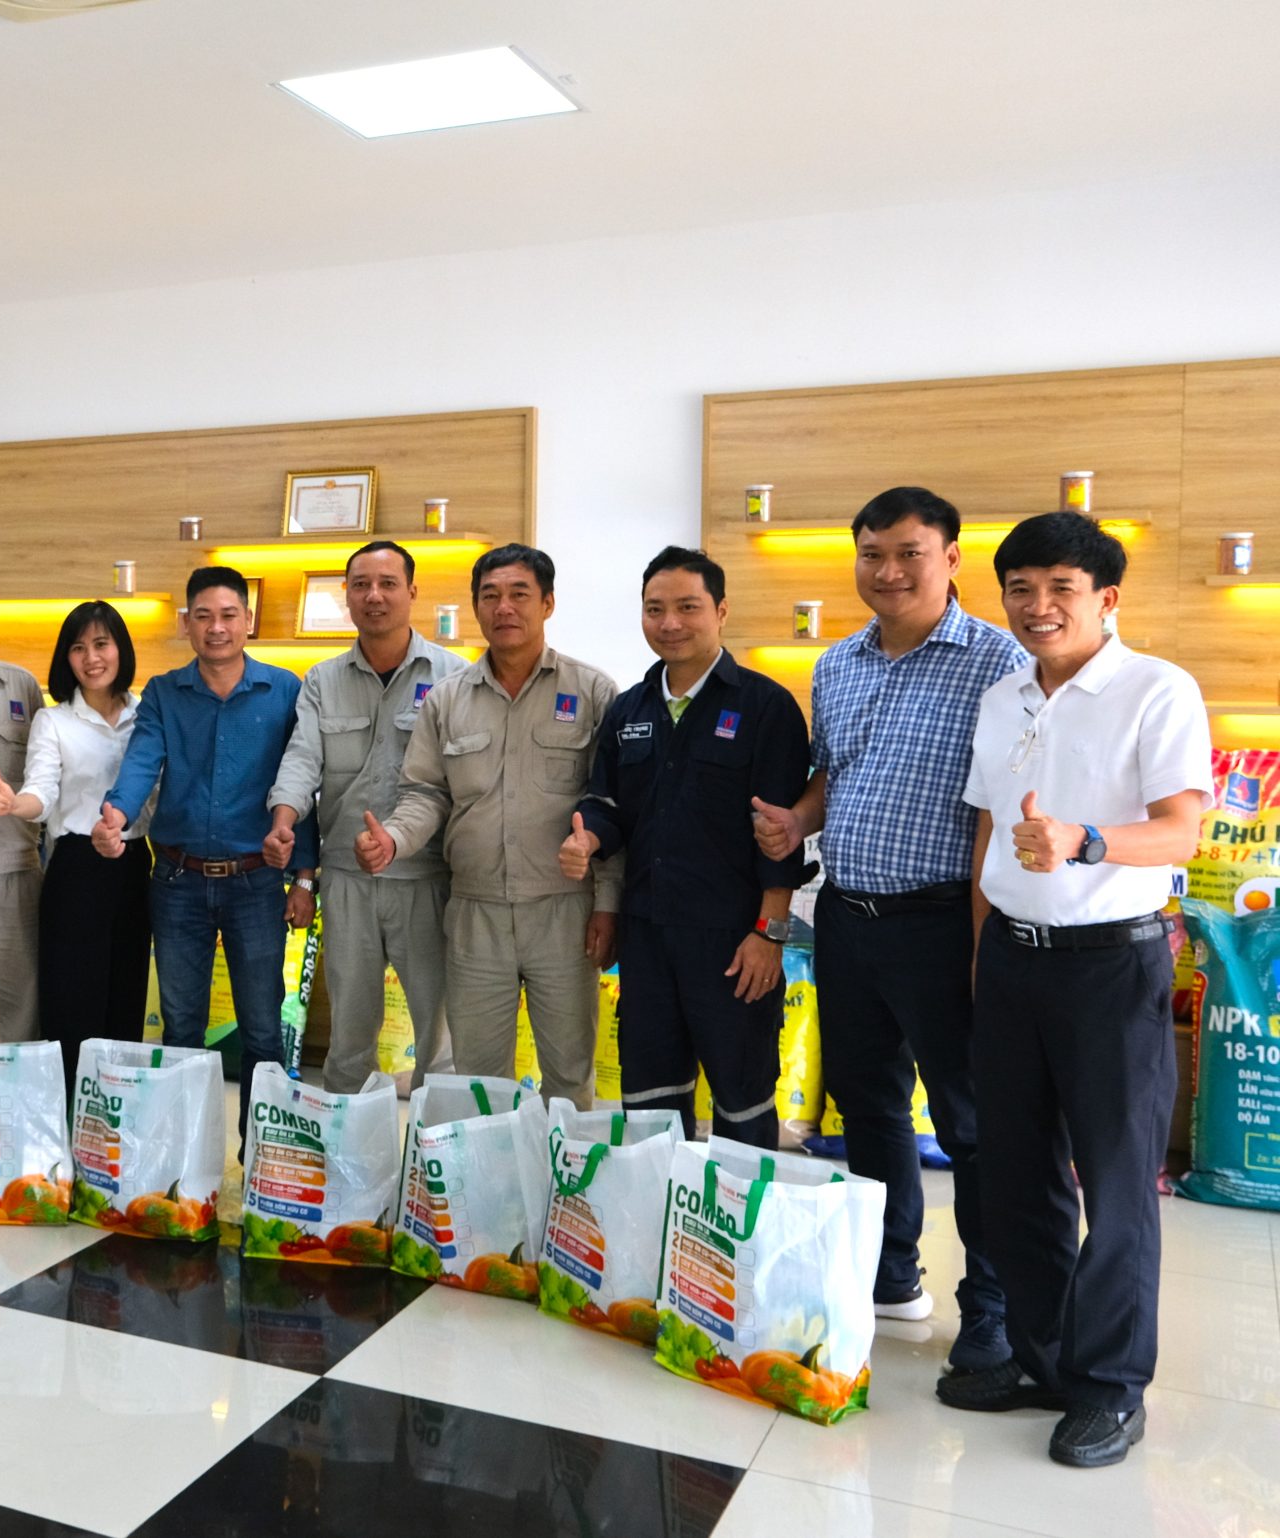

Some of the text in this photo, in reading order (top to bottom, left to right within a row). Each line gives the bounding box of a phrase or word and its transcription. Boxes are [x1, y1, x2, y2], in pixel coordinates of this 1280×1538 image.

[1211, 819, 1265, 844] PHÚ
[1208, 1004, 1263, 1038] NPK
[254, 1102, 322, 1139] COMBO
[412, 1150, 417, 1164] 1
[409, 1167, 418, 1181] 2
[250, 1176, 258, 1190] 4
[407, 1183, 416, 1197] 3
[248, 1192, 257, 1206] 5
[406, 1200, 415, 1213] 4
[403, 1214, 413, 1229] 5
[550, 1206, 558, 1222] 3
[673, 1211, 678, 1227] 1
[548, 1225, 555, 1241] 4
[672, 1231, 680, 1248] 2
[546, 1242, 553, 1258] 5
[670, 1250, 677, 1267] 3
[668, 1288, 677, 1305] 5
